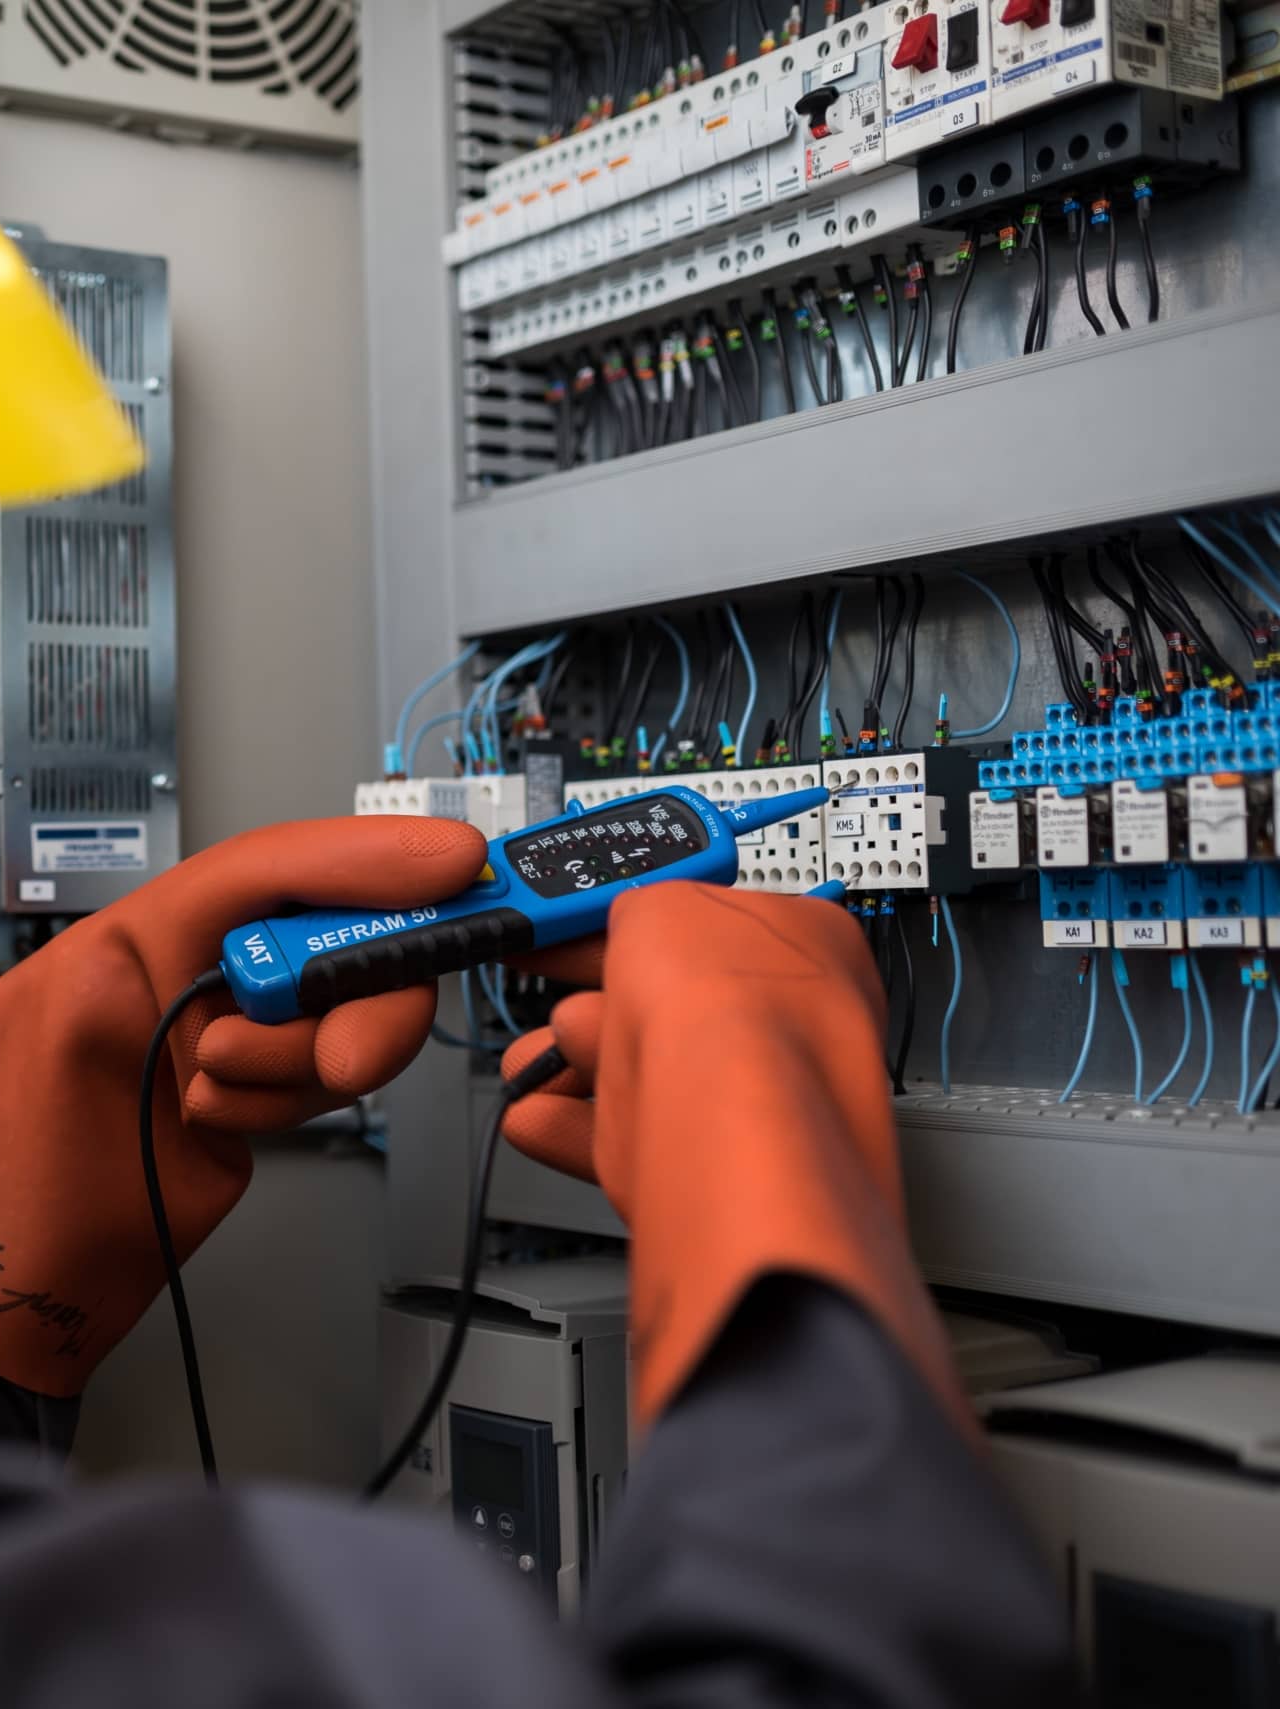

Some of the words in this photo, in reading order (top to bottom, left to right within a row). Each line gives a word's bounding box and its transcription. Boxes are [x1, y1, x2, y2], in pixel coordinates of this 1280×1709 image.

[593, 825, 606, 834] 50
[612, 821, 625, 834] 120
[630, 820, 645, 834] 230
[651, 821, 666, 836] 400
[671, 823, 688, 839] 690
[836, 819, 855, 831] KM5
[543, 836, 554, 845] 12
[577, 874, 588, 882] R
[306, 913, 407, 952] SEFRAM
[411, 906, 438, 923] 50
[1065, 926, 1080, 937] KA1
[1134, 927, 1153, 939] KA2
[1210, 927, 1229, 938] KA3
[244, 933, 273, 965] VAT
